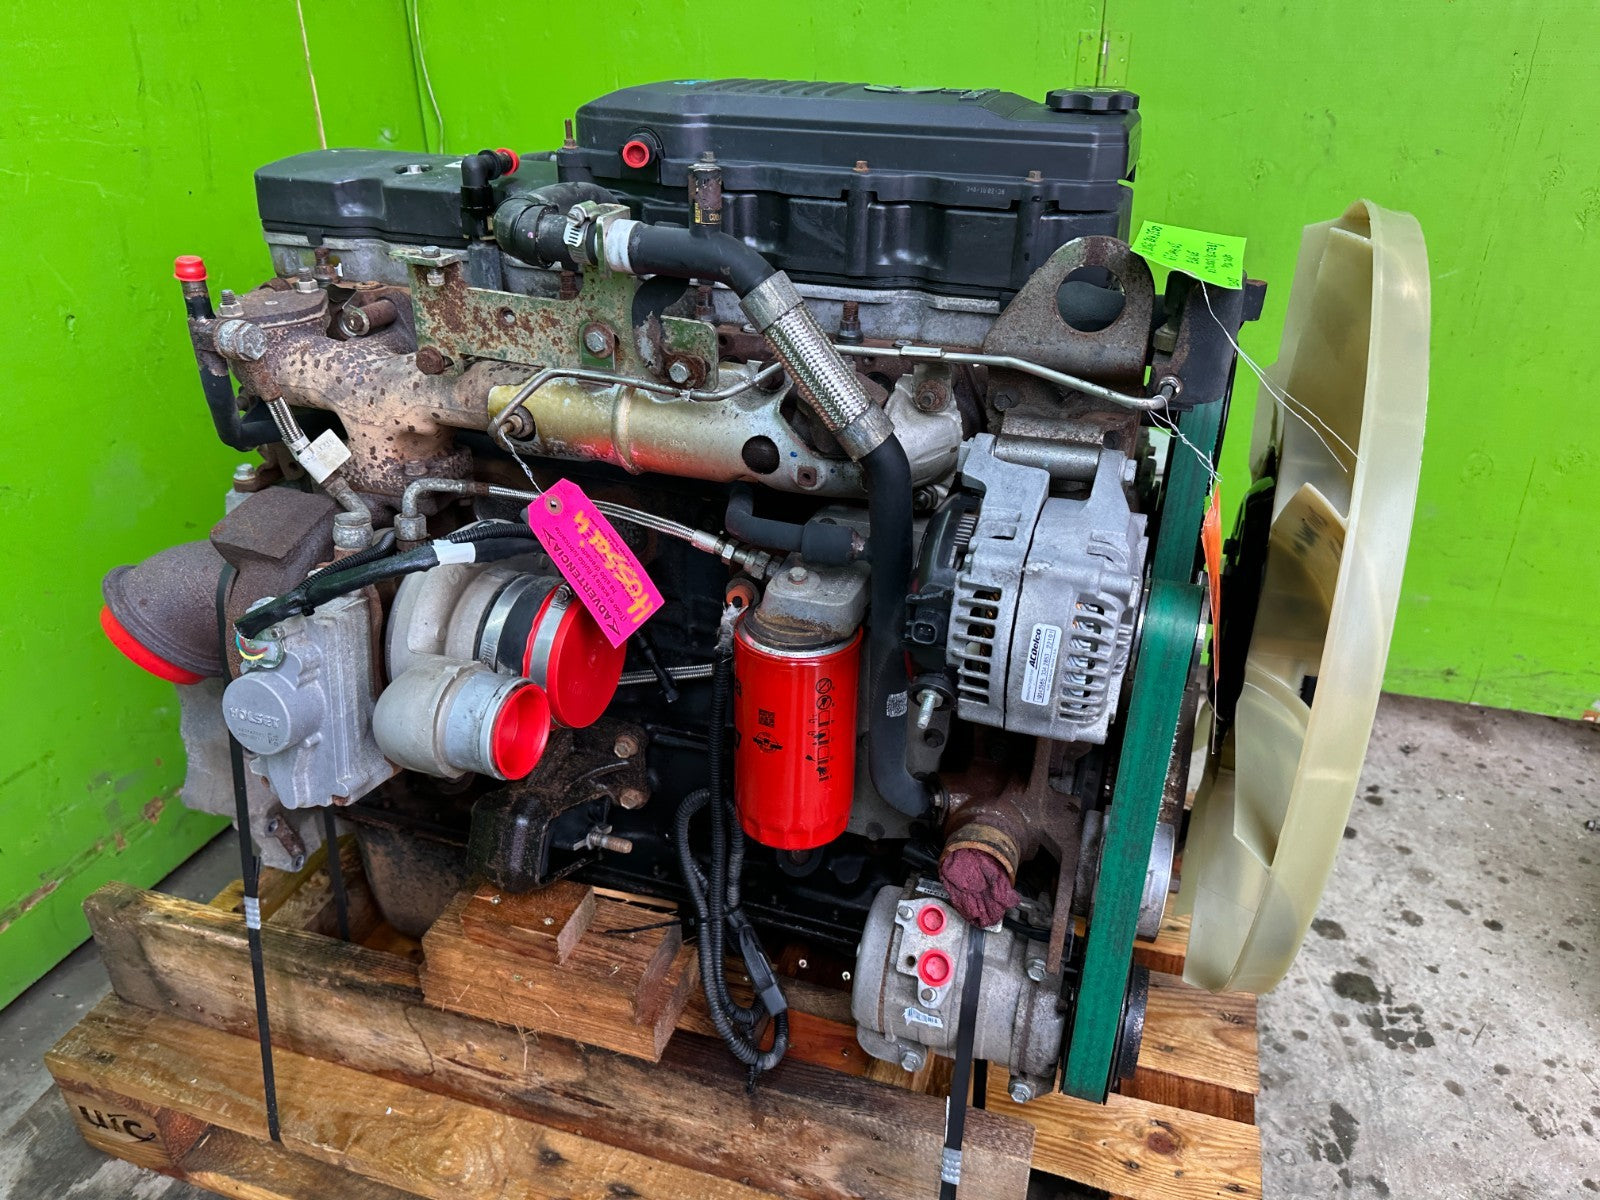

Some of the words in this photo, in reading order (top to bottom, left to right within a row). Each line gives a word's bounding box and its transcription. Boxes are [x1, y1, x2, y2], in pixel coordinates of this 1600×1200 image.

[552, 525, 579, 558] lubricante
[550, 542, 613, 621] ADVERTENCIA
[593, 578, 610, 598] aceite
[598, 570, 611, 585] sido
[1028, 628, 1041, 667] ACDelco
[230, 707, 280, 728] HOLSET
